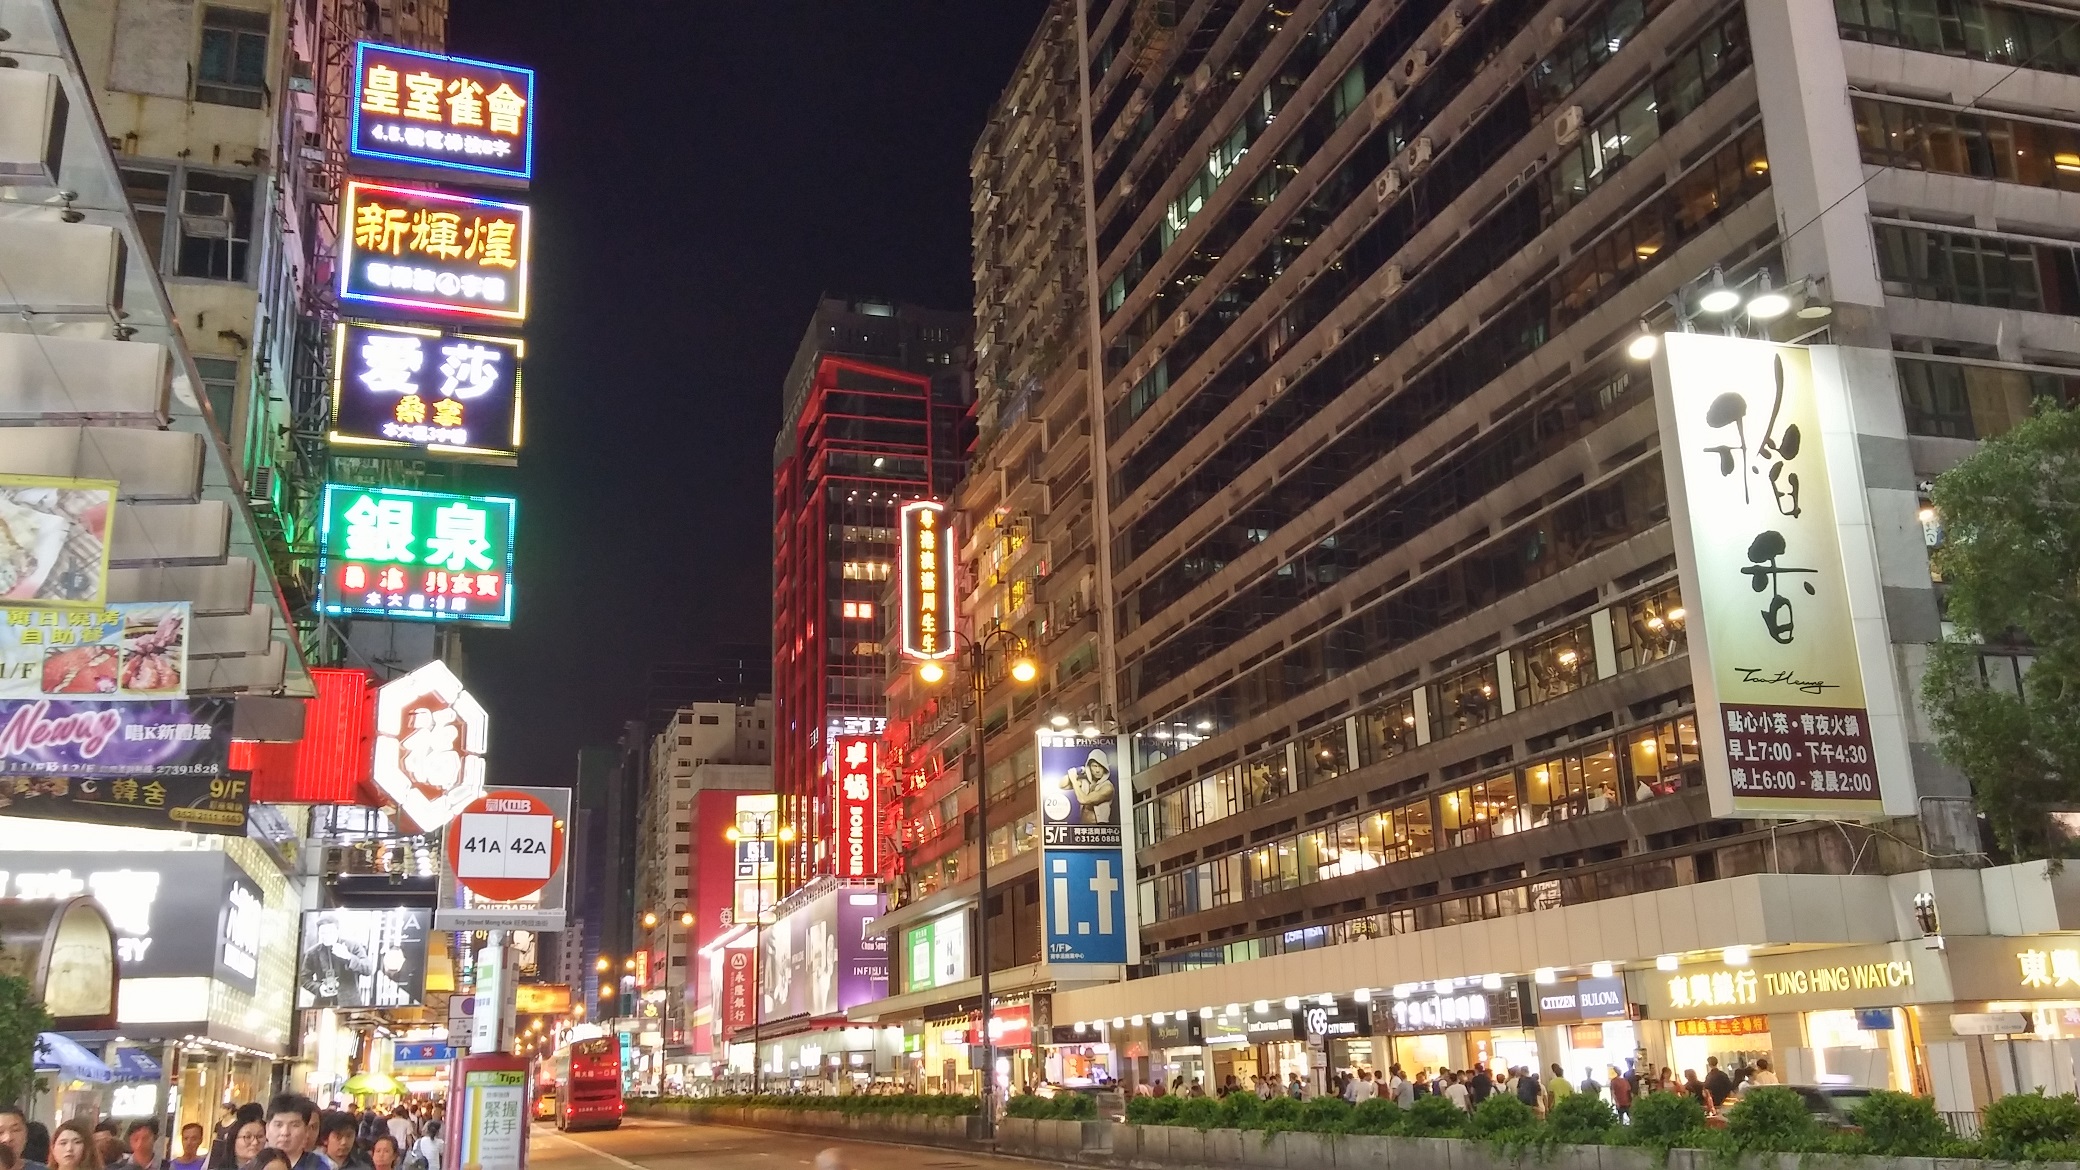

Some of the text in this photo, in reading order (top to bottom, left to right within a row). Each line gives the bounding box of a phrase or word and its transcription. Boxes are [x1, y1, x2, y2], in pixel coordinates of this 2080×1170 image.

[361, 64, 526, 136] 皇室雀會
[355, 202, 517, 269] 新輝煌
[359, 335, 501, 399] 愛莎
[343, 494, 494, 571] 銀泉
[1076, 738, 1115, 746] PHYSICAL
[210, 778, 246, 799] 9/F
[1045, 827, 1068, 844] 5/F
[464, 837, 501, 853] 41A
[510, 838, 546, 854] 42A
[1053, 859, 1119, 935] i.t
[1764, 970, 1808, 996] TUNG
[1810, 966, 1850, 992] HING
[1851, 960, 1914, 989] WATCH
[1541, 995, 1576, 1010] CITIZEN
[1581, 991, 1619, 1007] BULOVA
[485, 1101, 518, 1118] 緊握
[483, 1119, 516, 1135] 扶手
